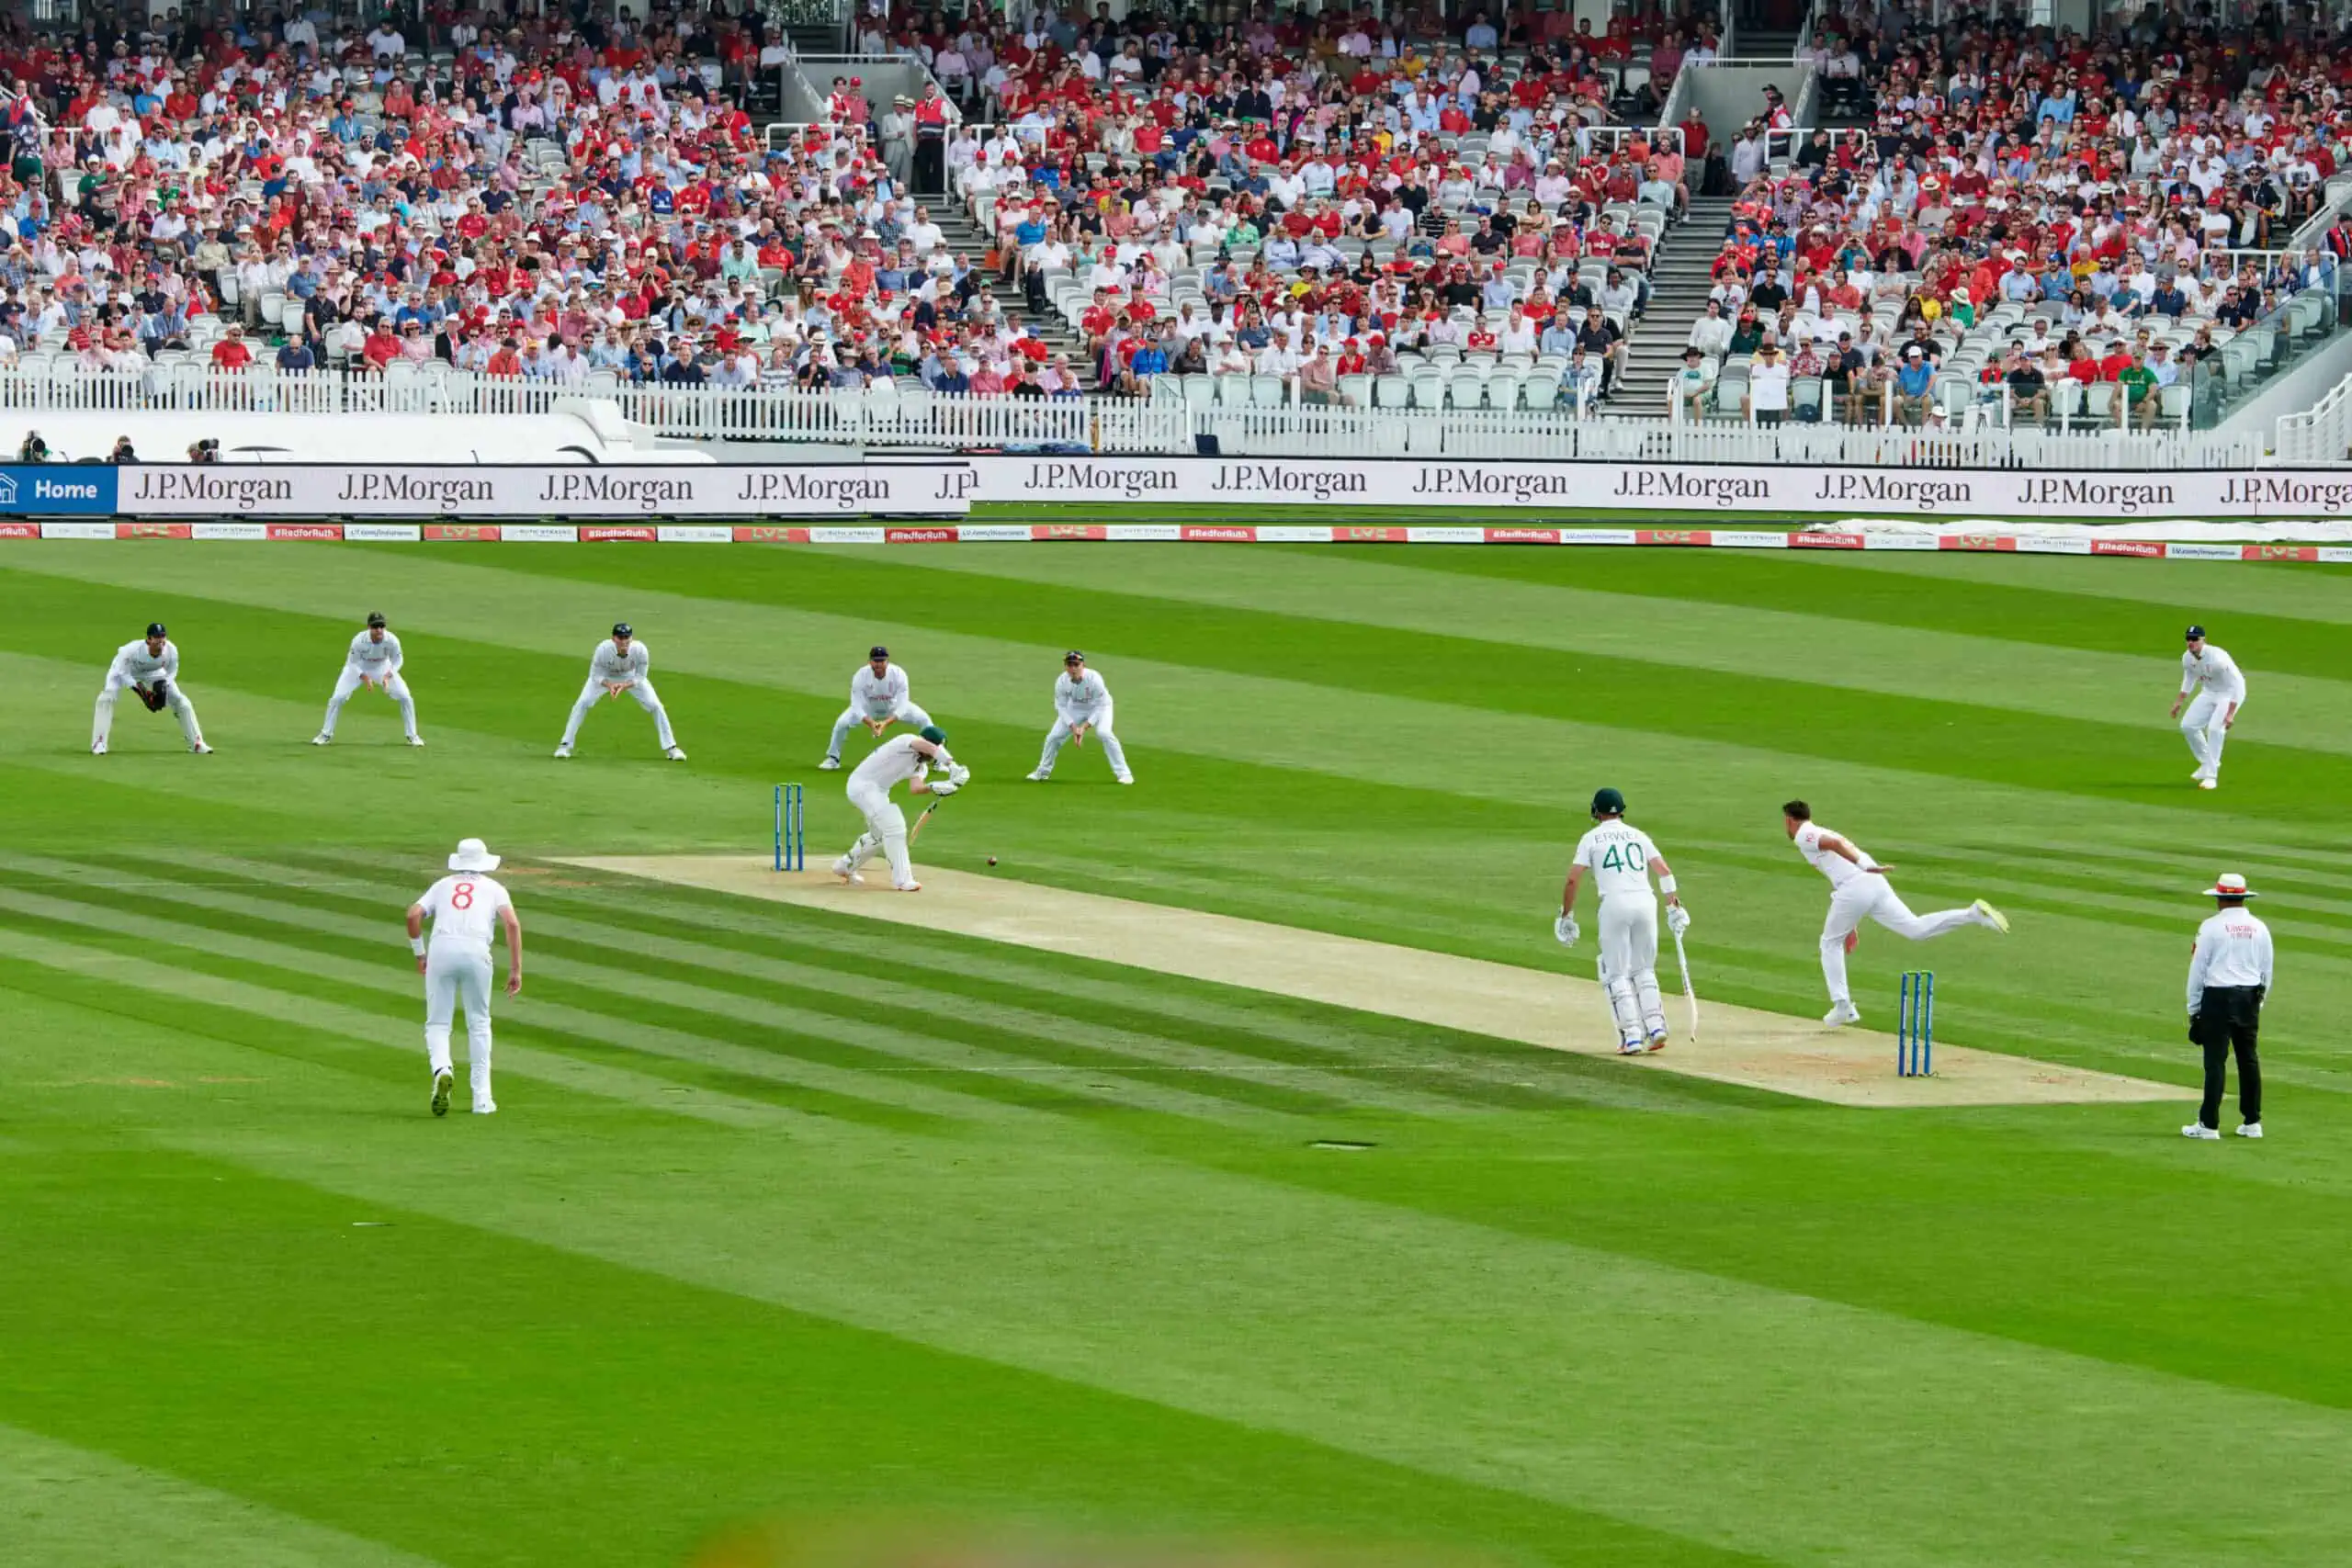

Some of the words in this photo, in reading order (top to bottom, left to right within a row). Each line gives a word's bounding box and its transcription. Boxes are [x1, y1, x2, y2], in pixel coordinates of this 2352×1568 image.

[35, 479, 97, 499] Home
[134, 473, 292, 509] J.P.Morgan
[337, 474, 493, 510] J.P.Morgan
[539, 474, 694, 510] J.P.Morgan
[738, 474, 889, 509] J.P.Morgan
[1024, 464, 1178, 497] J.P.Morgan
[1212, 466, 1366, 500] J.P.Morgan
[1412, 468, 1567, 502] J.P.Morgan
[1613, 470, 1770, 505] J.P.Morgan
[1815, 474, 1972, 509] J.P.Morgan
[2018, 478, 2175, 513] J.P.Morgan
[275, 527, 334, 537] #RedforRuth
[588, 528, 649, 538] #RedforRuth
[890, 530, 949, 540] #RedforRuth
[1188, 528, 1249, 538] #RedforRuth
[1492, 529, 1554, 539] #RedforRuth
[2098, 542, 2158, 555] #RedforRuth
[1602, 842, 1644, 874] 40
[452, 882, 474, 910] 8
